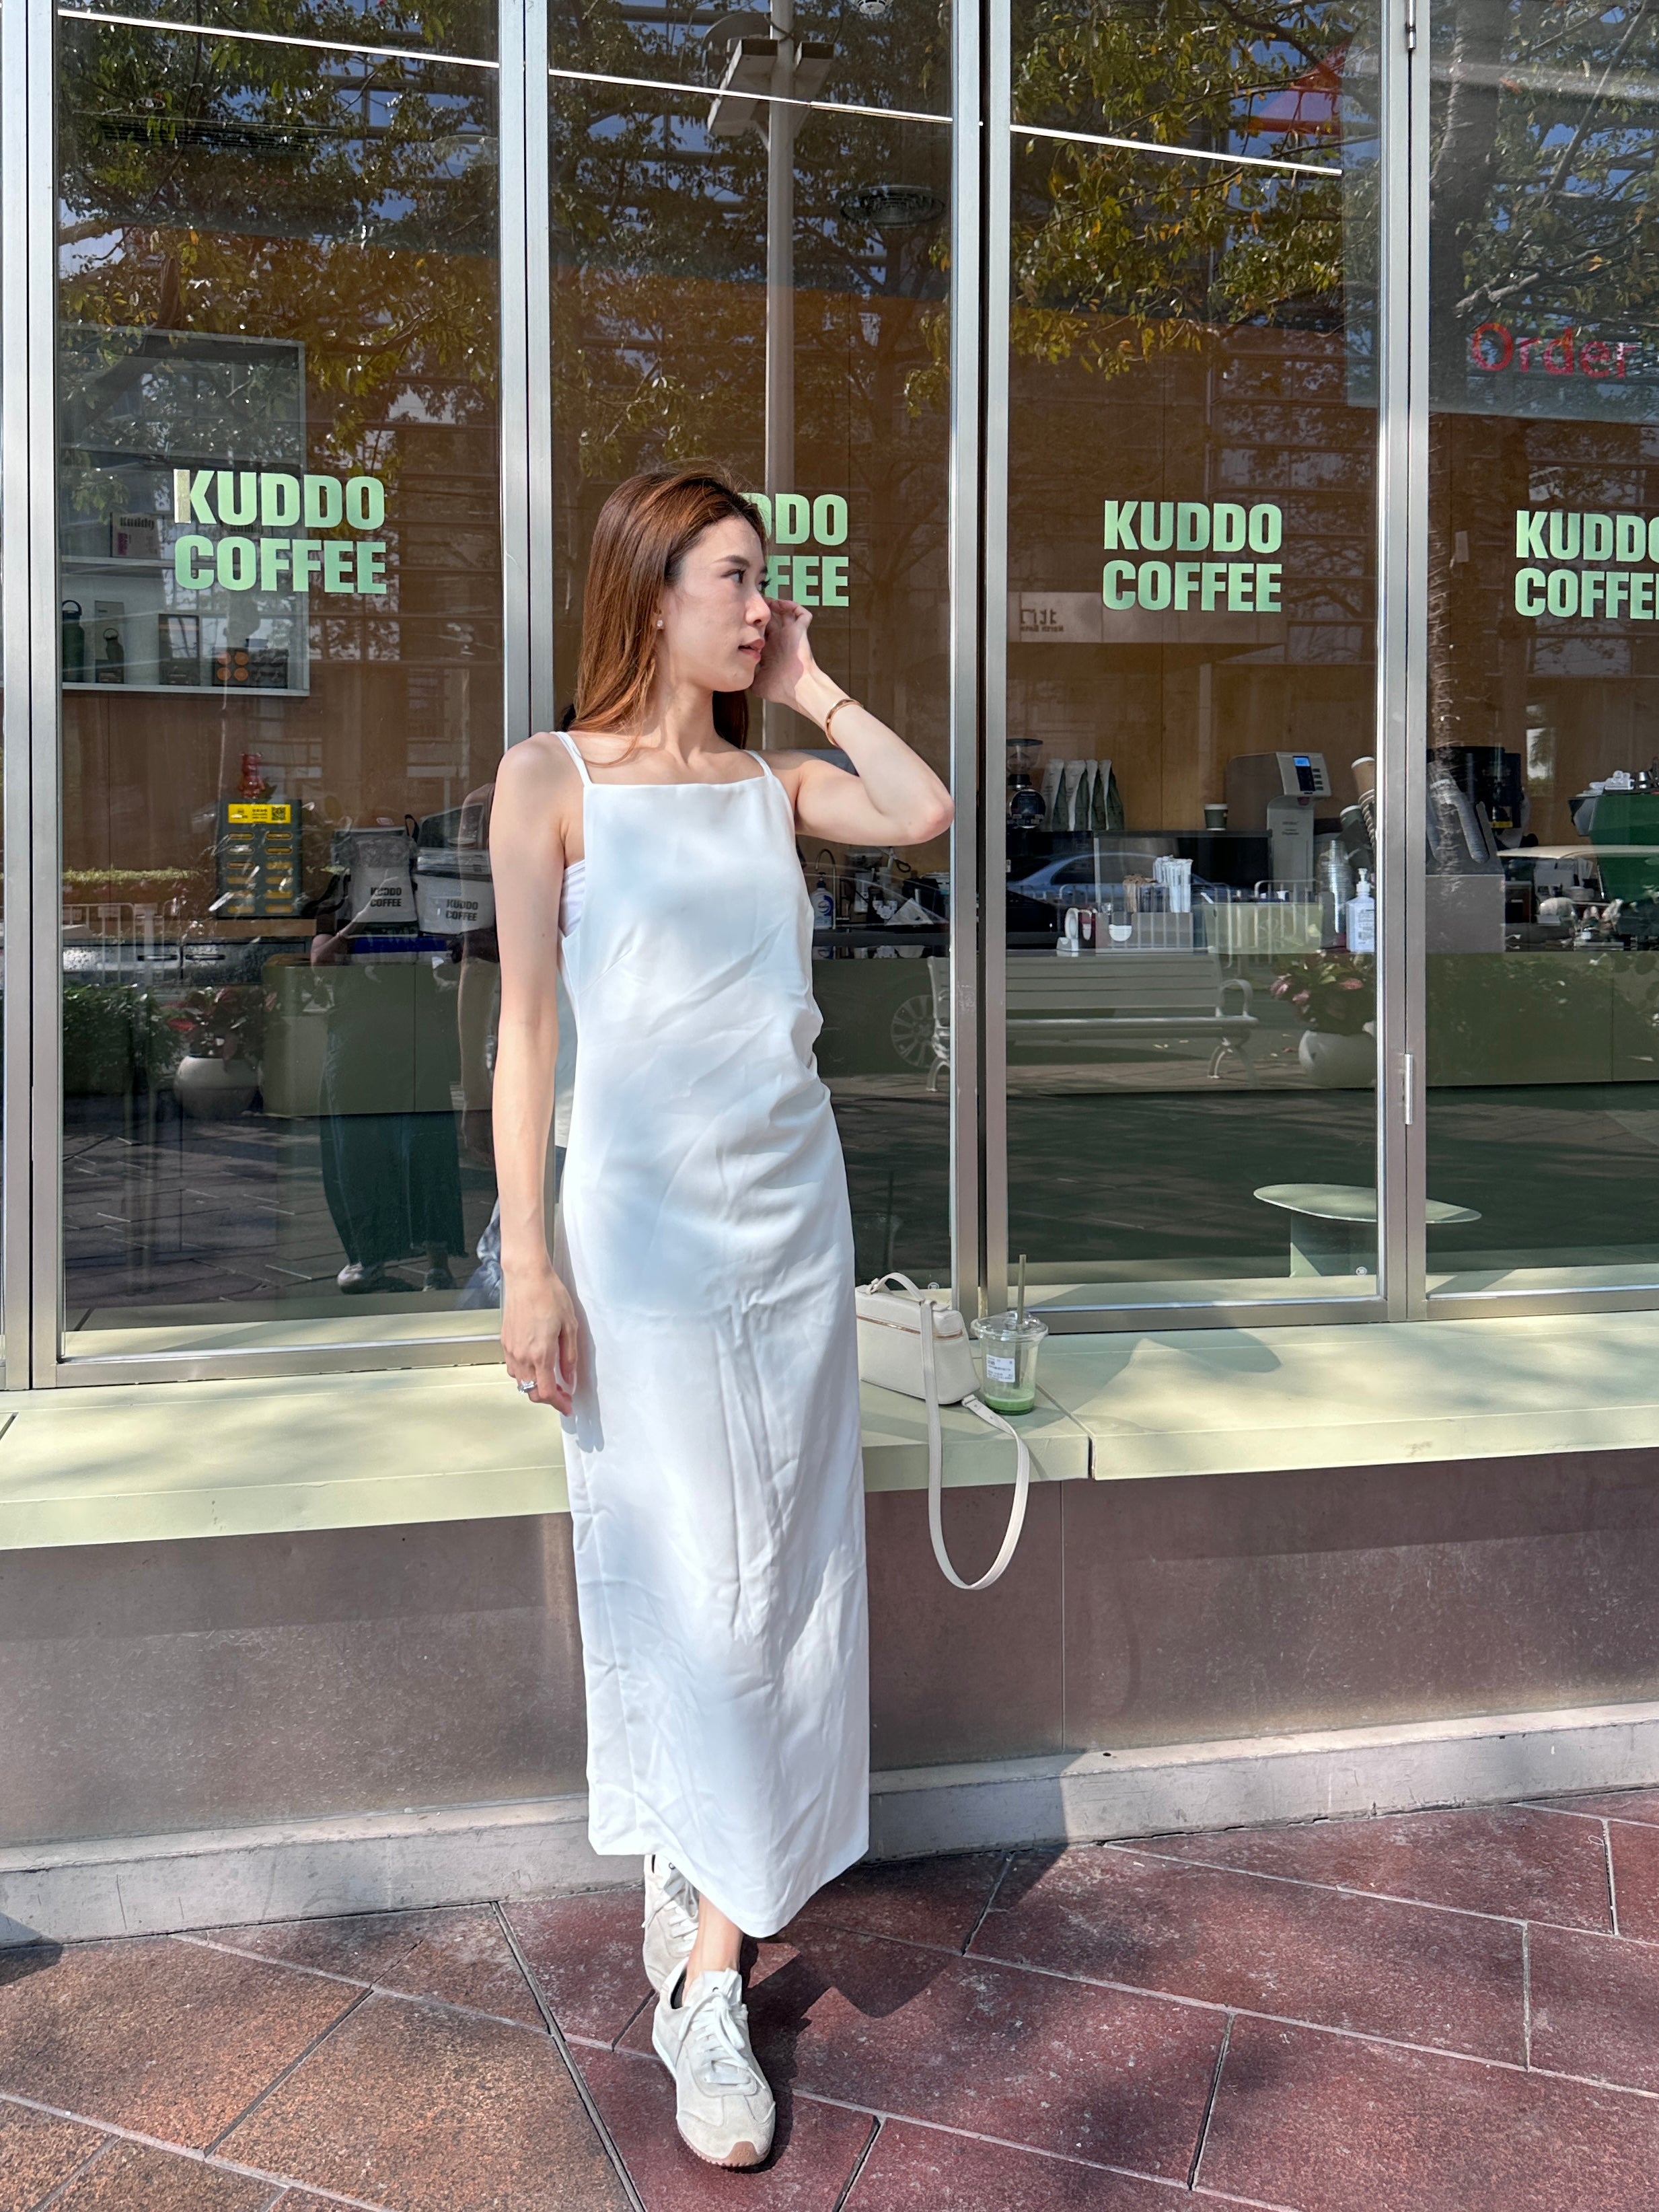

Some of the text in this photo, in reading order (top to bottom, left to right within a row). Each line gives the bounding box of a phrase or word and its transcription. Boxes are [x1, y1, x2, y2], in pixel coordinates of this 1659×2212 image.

[1472, 323, 1637, 378] Order
[174, 469, 385, 530] KUDDO
[1103, 500, 1282, 554] KUDDO
[174, 535, 387, 594] COFFEE
[1103, 560, 1282, 612] COFFEE
[1514, 567, 1659, 620] COFFE
[371, 898, 402, 907] COFFEE
[446, 910, 478, 921] COFFEE
